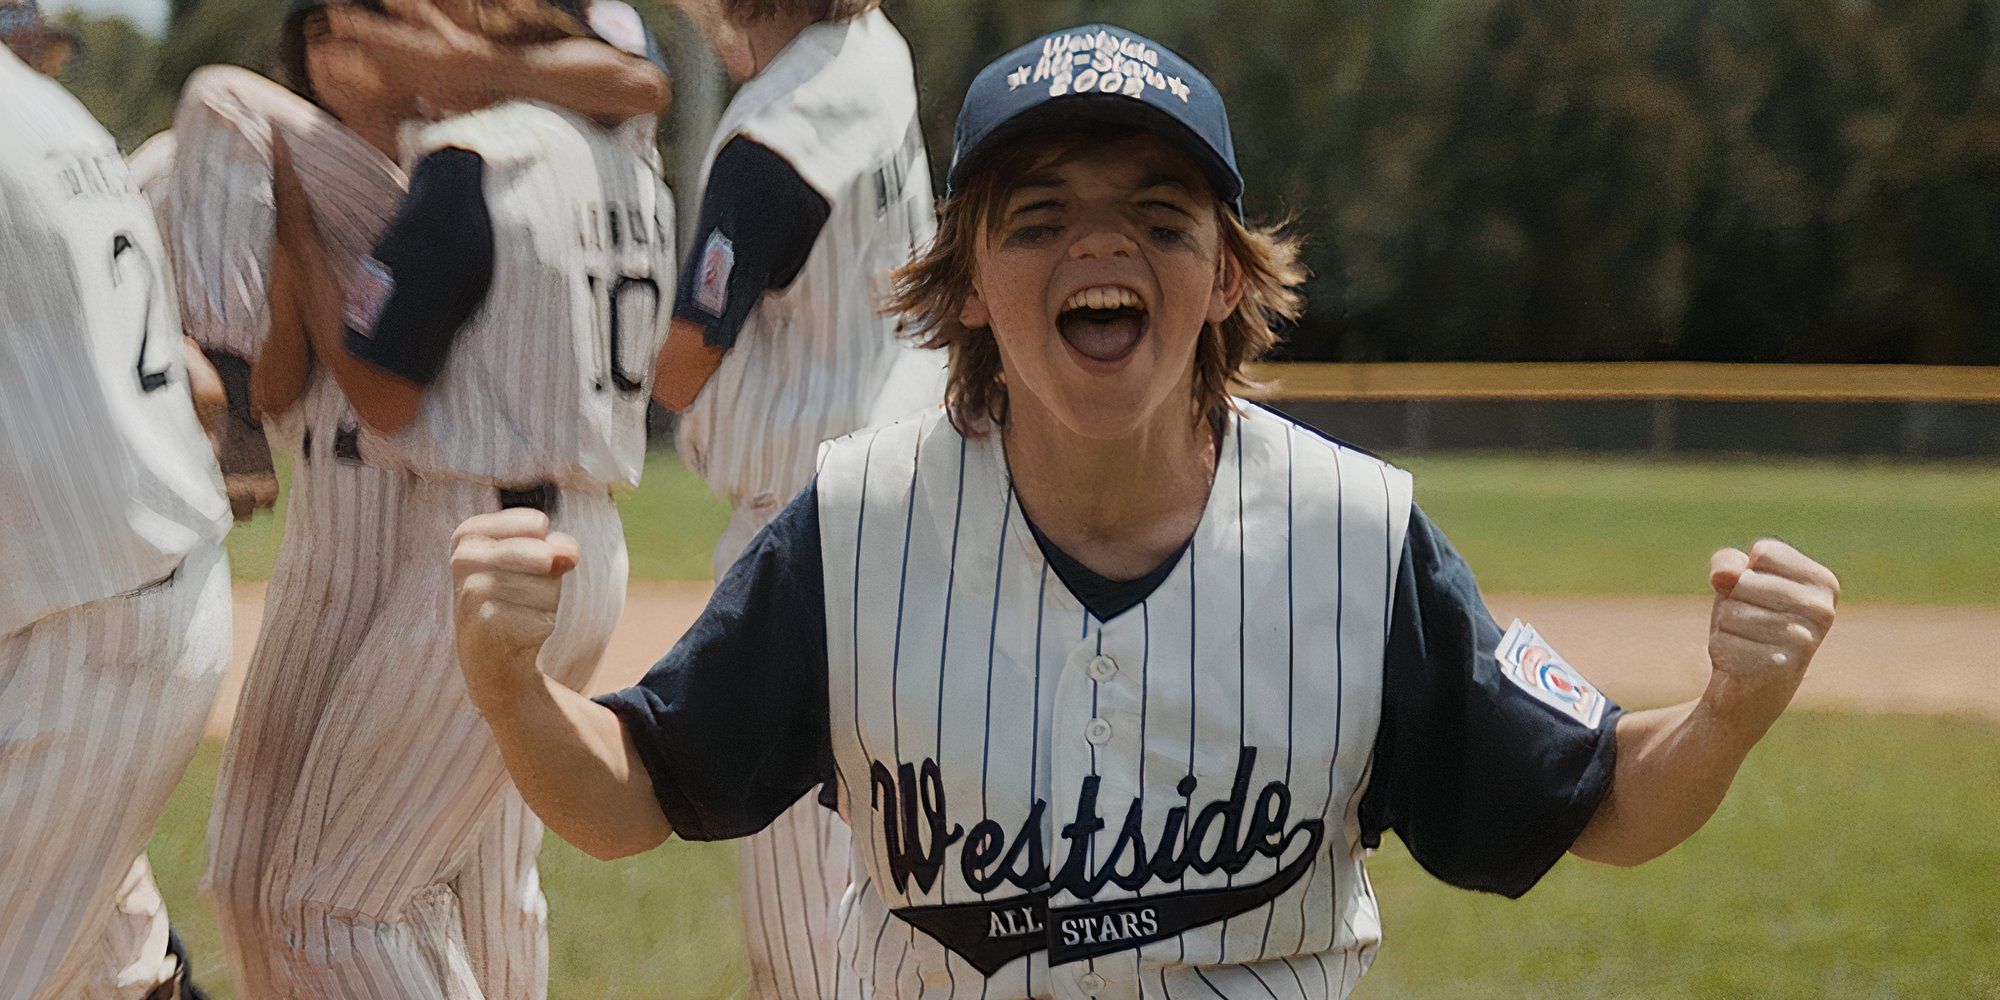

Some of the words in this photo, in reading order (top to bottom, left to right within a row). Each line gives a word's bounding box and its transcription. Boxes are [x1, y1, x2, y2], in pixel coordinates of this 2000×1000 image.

[871, 745, 1293, 899] Westside
[988, 907, 1043, 937] ALL
[1061, 907, 1159, 946] STARS
